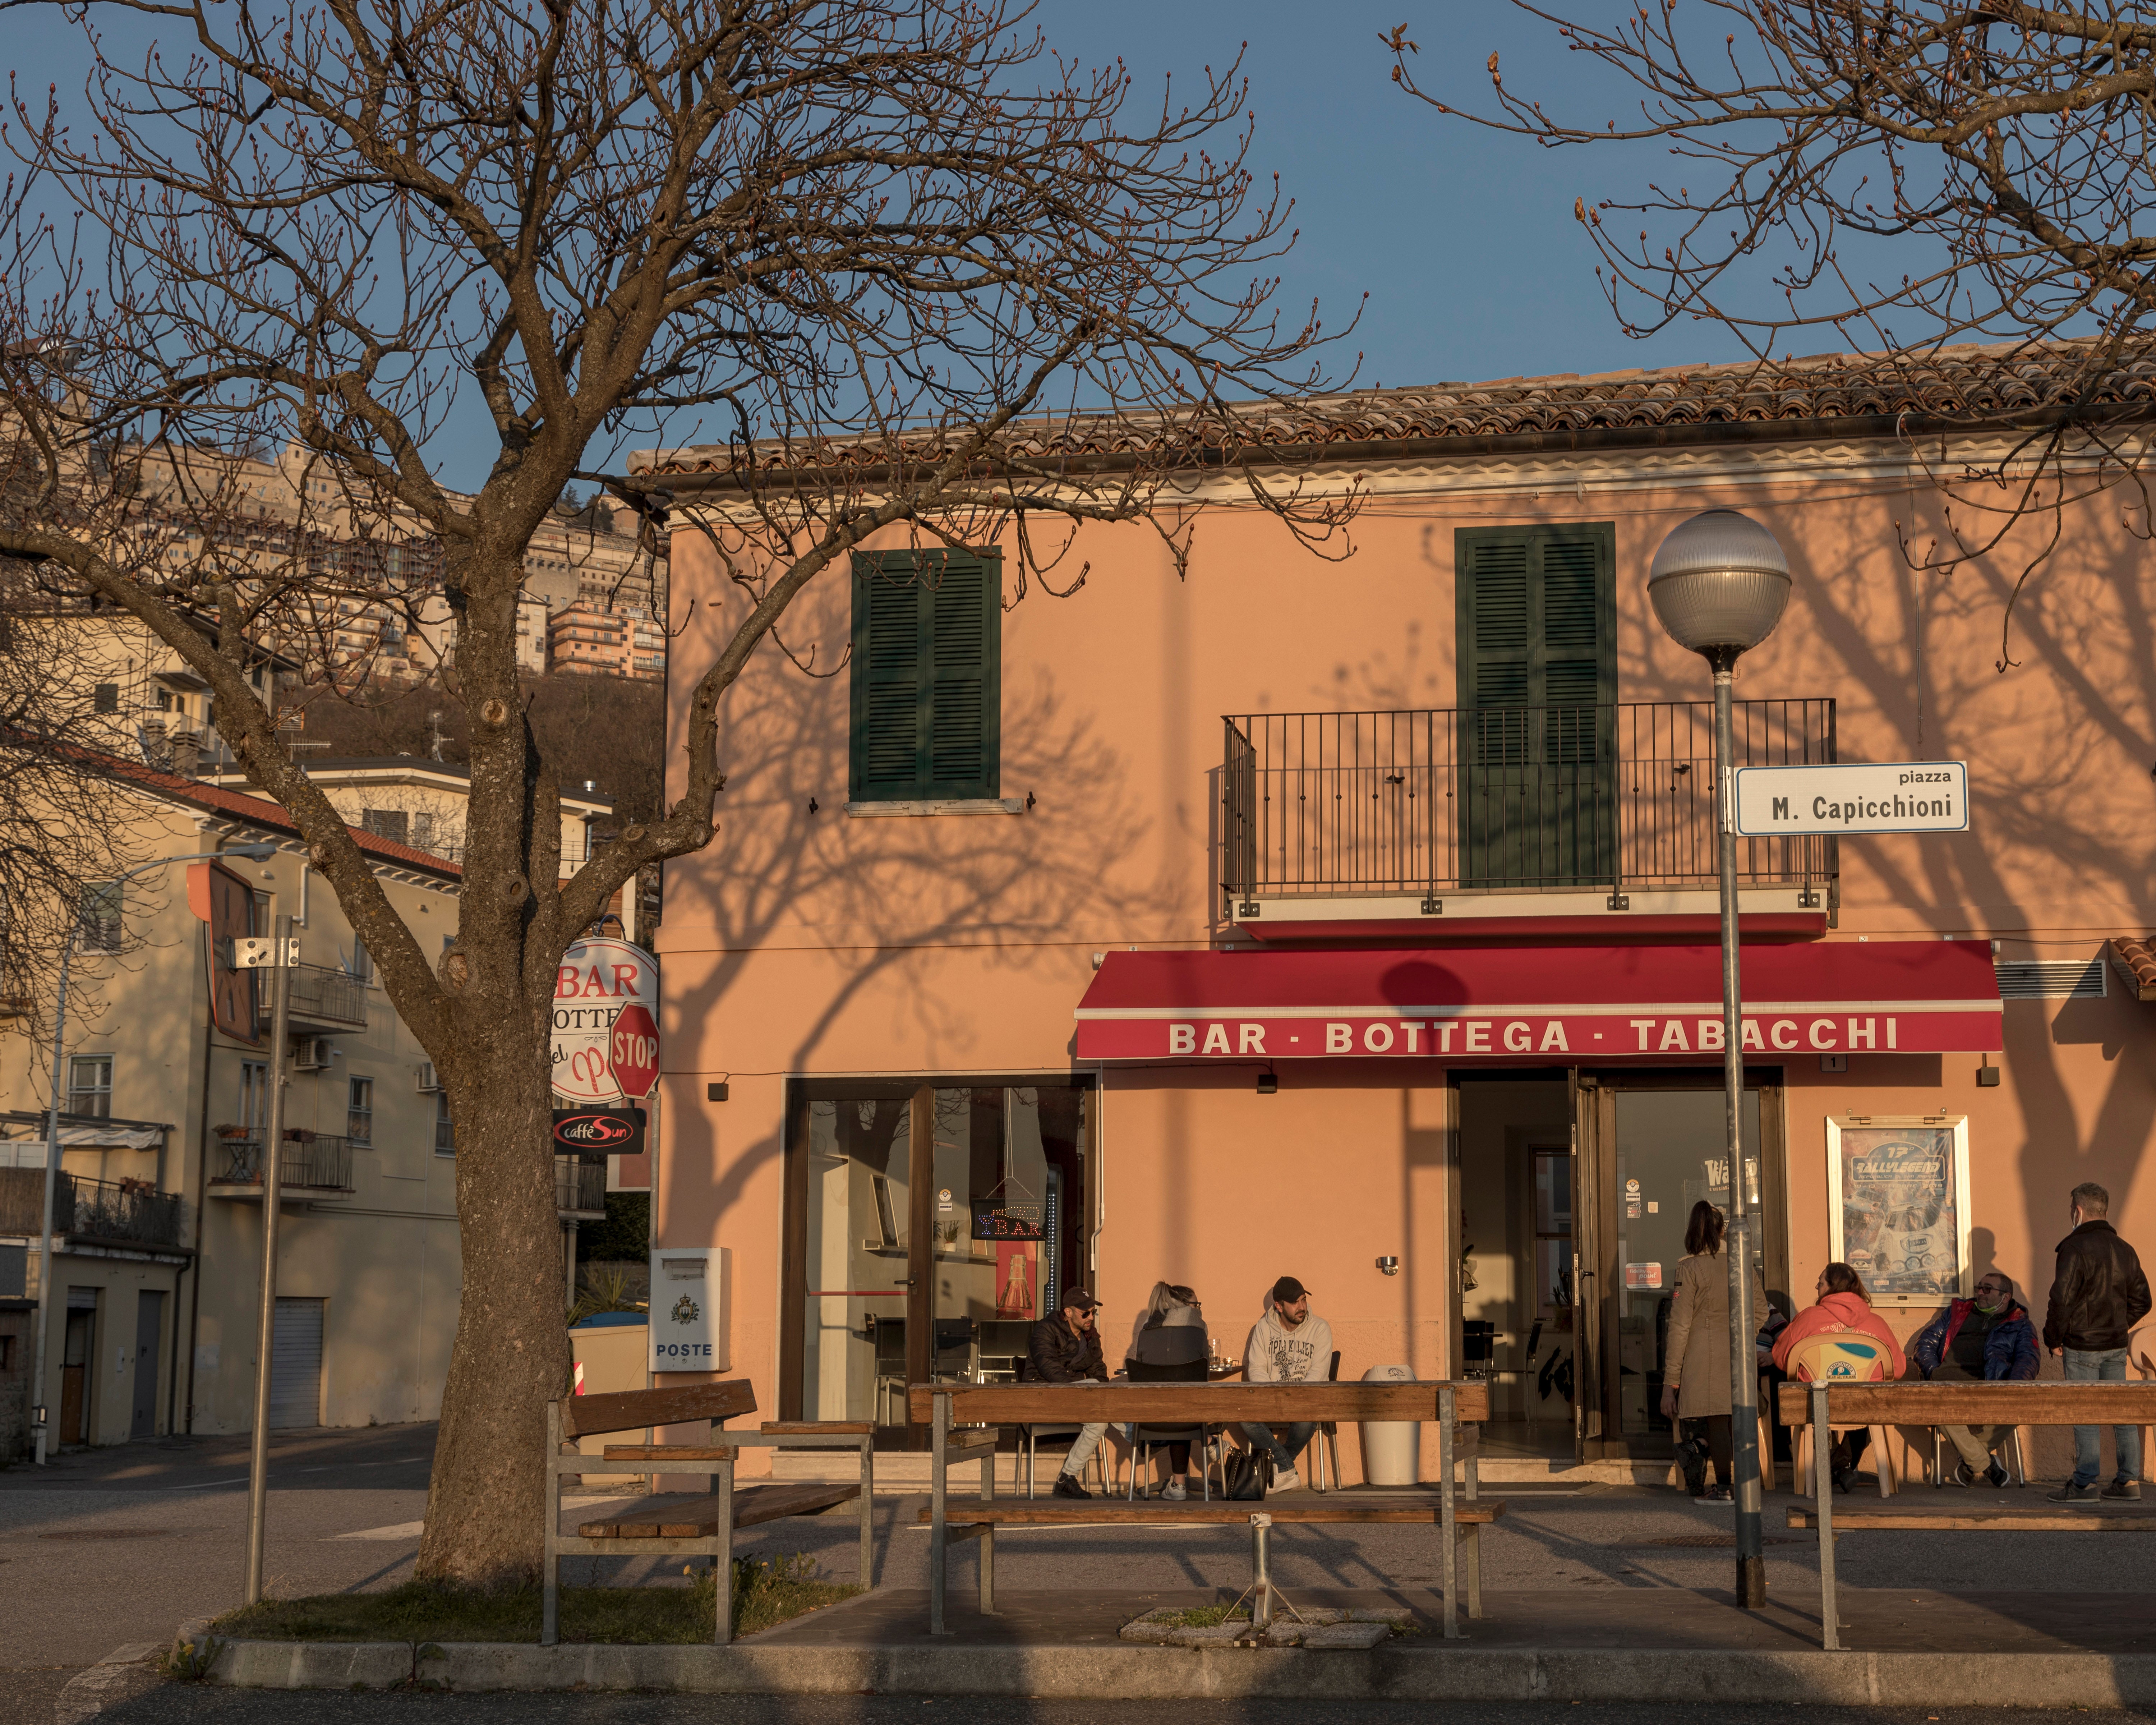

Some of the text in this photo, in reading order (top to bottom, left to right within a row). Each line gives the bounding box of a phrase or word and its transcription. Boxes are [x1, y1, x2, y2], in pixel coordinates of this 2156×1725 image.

[1900, 770, 1952, 786] piazza
[1773, 794, 1951, 824] M. Capicchioni
[554, 964, 640, 998] BAR
[1169, 1023, 1266, 1054] BAR
[1326, 1021, 1569, 1053] BOTTEGA
[1630, 1018, 1897, 1051] TABACCHI
[615, 1031, 657, 1069] STOP
[1831, 1057, 1835, 1067] 1
[564, 1123, 594, 1138] caffè
[995, 1220, 1041, 1235] BAR
[1639, 1271, 1657, 1280] point
[657, 1344, 712, 1356] POSTE
[1828, 1362, 1853, 1373] SAMMONTANA
